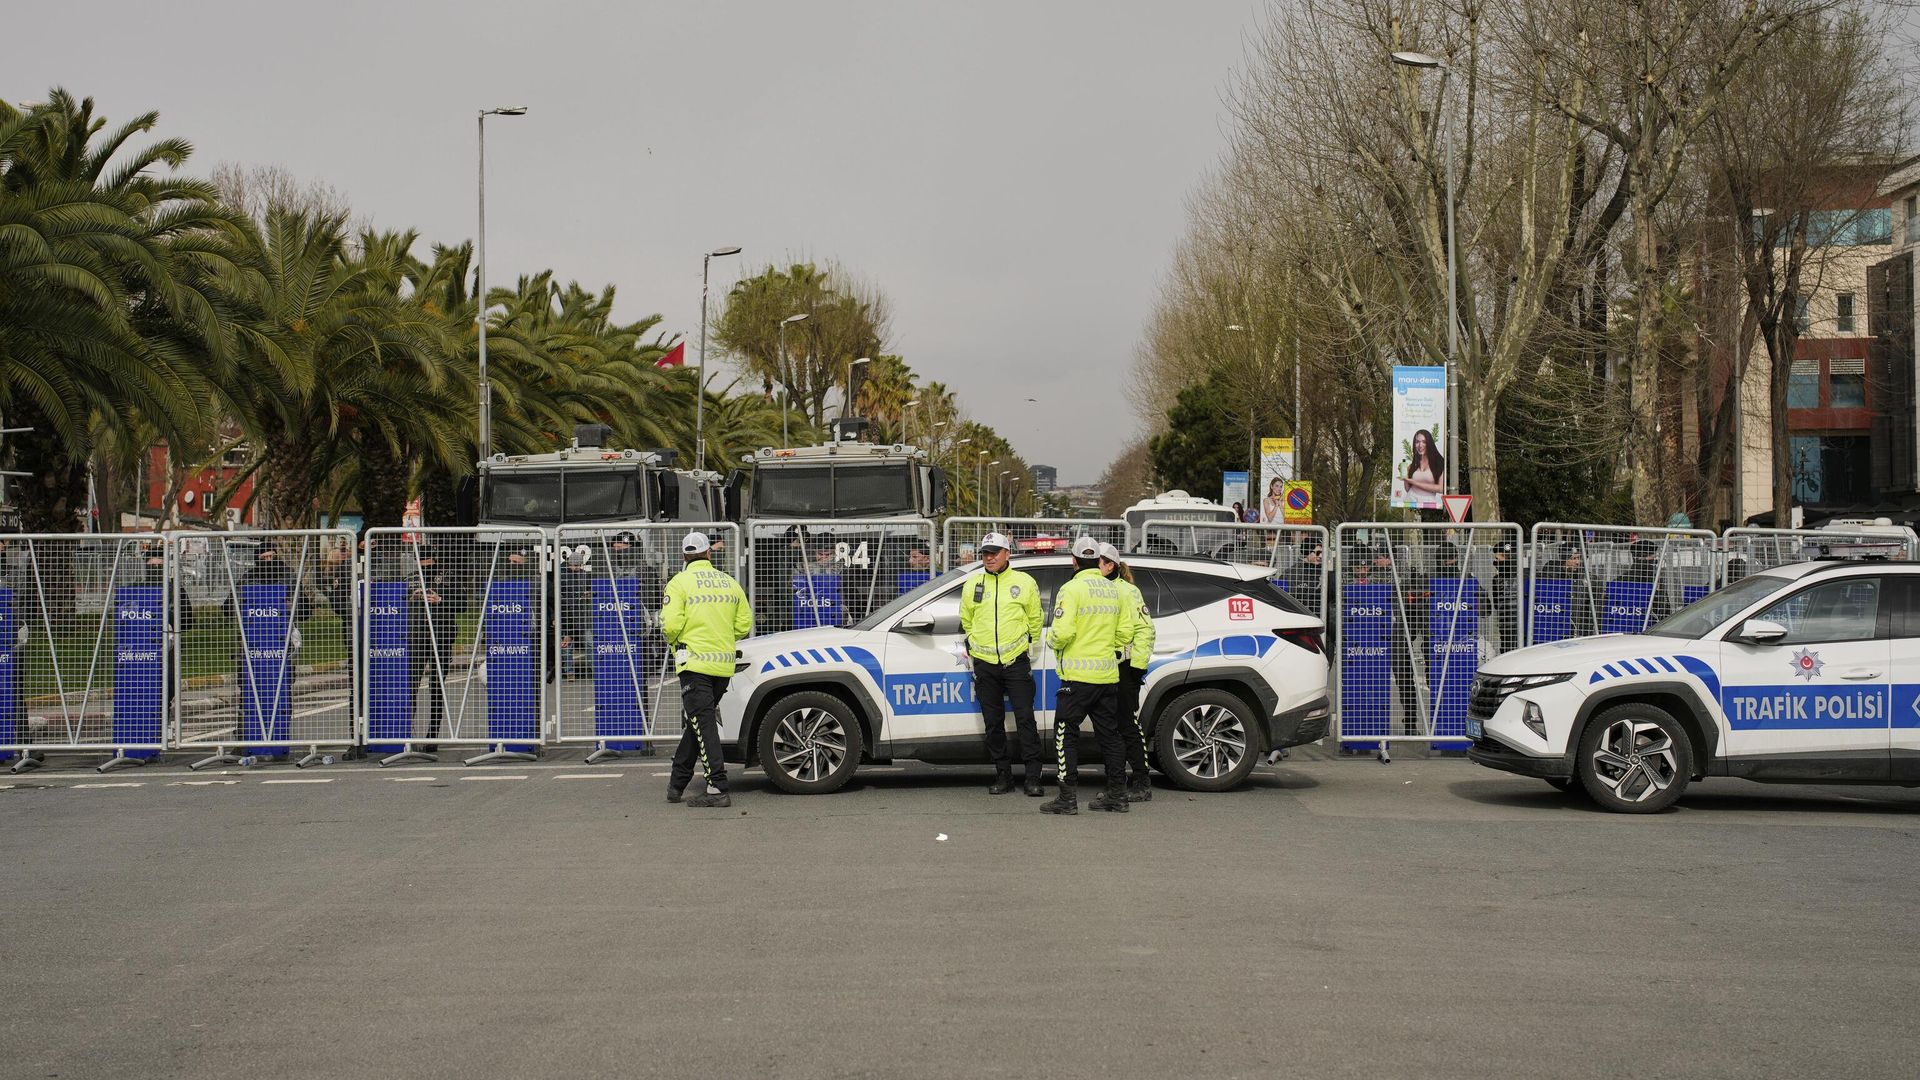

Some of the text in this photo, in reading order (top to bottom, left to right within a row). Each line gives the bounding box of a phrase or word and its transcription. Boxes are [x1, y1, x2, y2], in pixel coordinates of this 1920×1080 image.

[491, 602, 522, 614] POLİS
[1232, 600, 1251, 612] 112
[1533, 603, 1562, 613] OLİS
[1611, 605, 1642, 616] POLİS
[121, 609, 152, 620] POLİS
[249, 607, 279, 618] POLİS
[615, 644, 636, 653] KUVET
[892, 677, 964, 706] TRAFİK
[1733, 690, 1883, 720] TRAFİK POLİSİ
